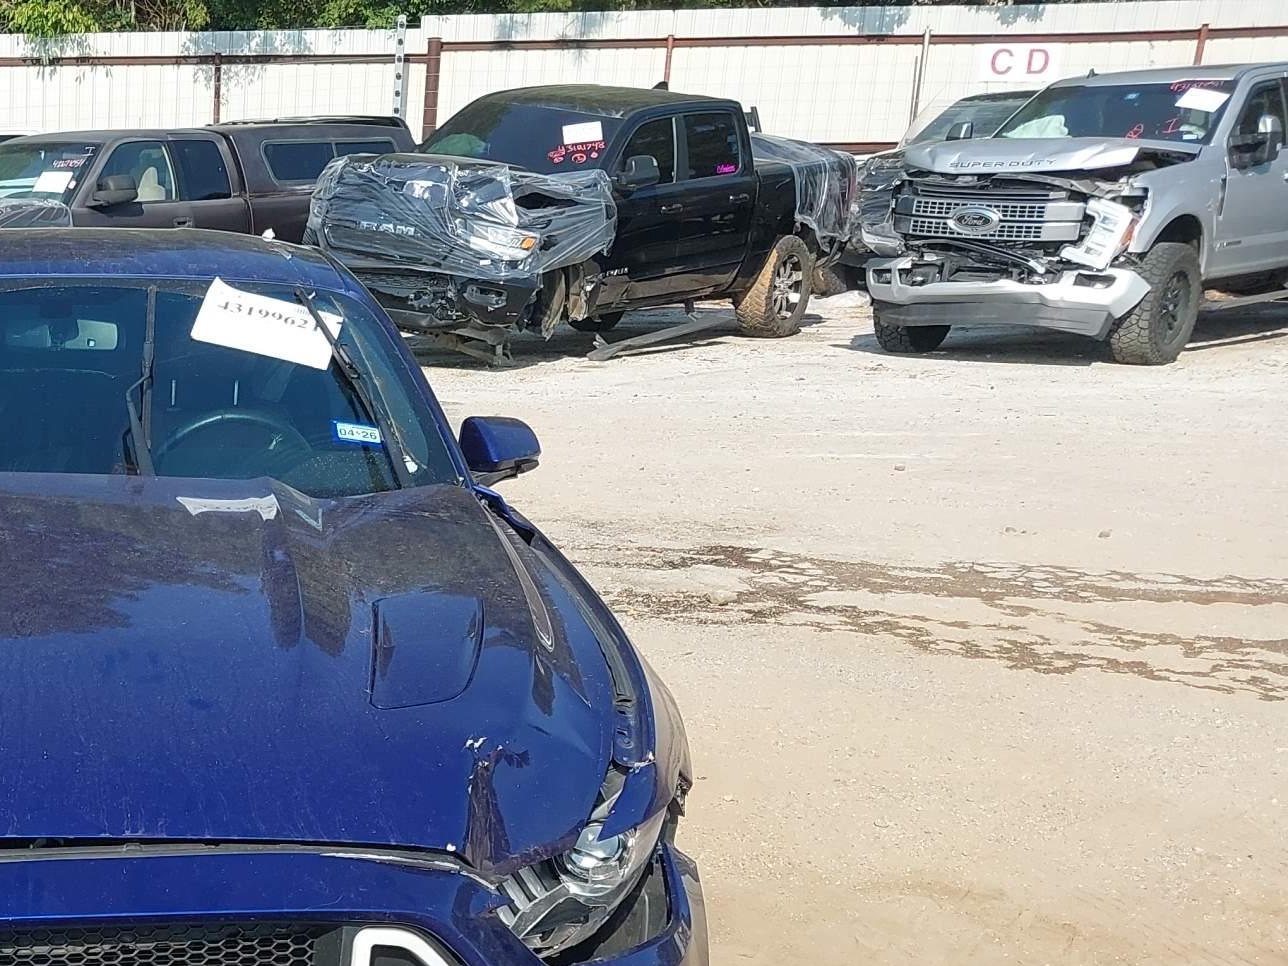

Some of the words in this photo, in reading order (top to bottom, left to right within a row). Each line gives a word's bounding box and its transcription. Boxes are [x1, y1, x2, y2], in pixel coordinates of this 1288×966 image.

[991, 48, 1014, 75] C
[1026, 48, 1050, 75] D
[949, 160, 1005, 169] SUPER
[1008, 159, 1057, 168] DUTY
